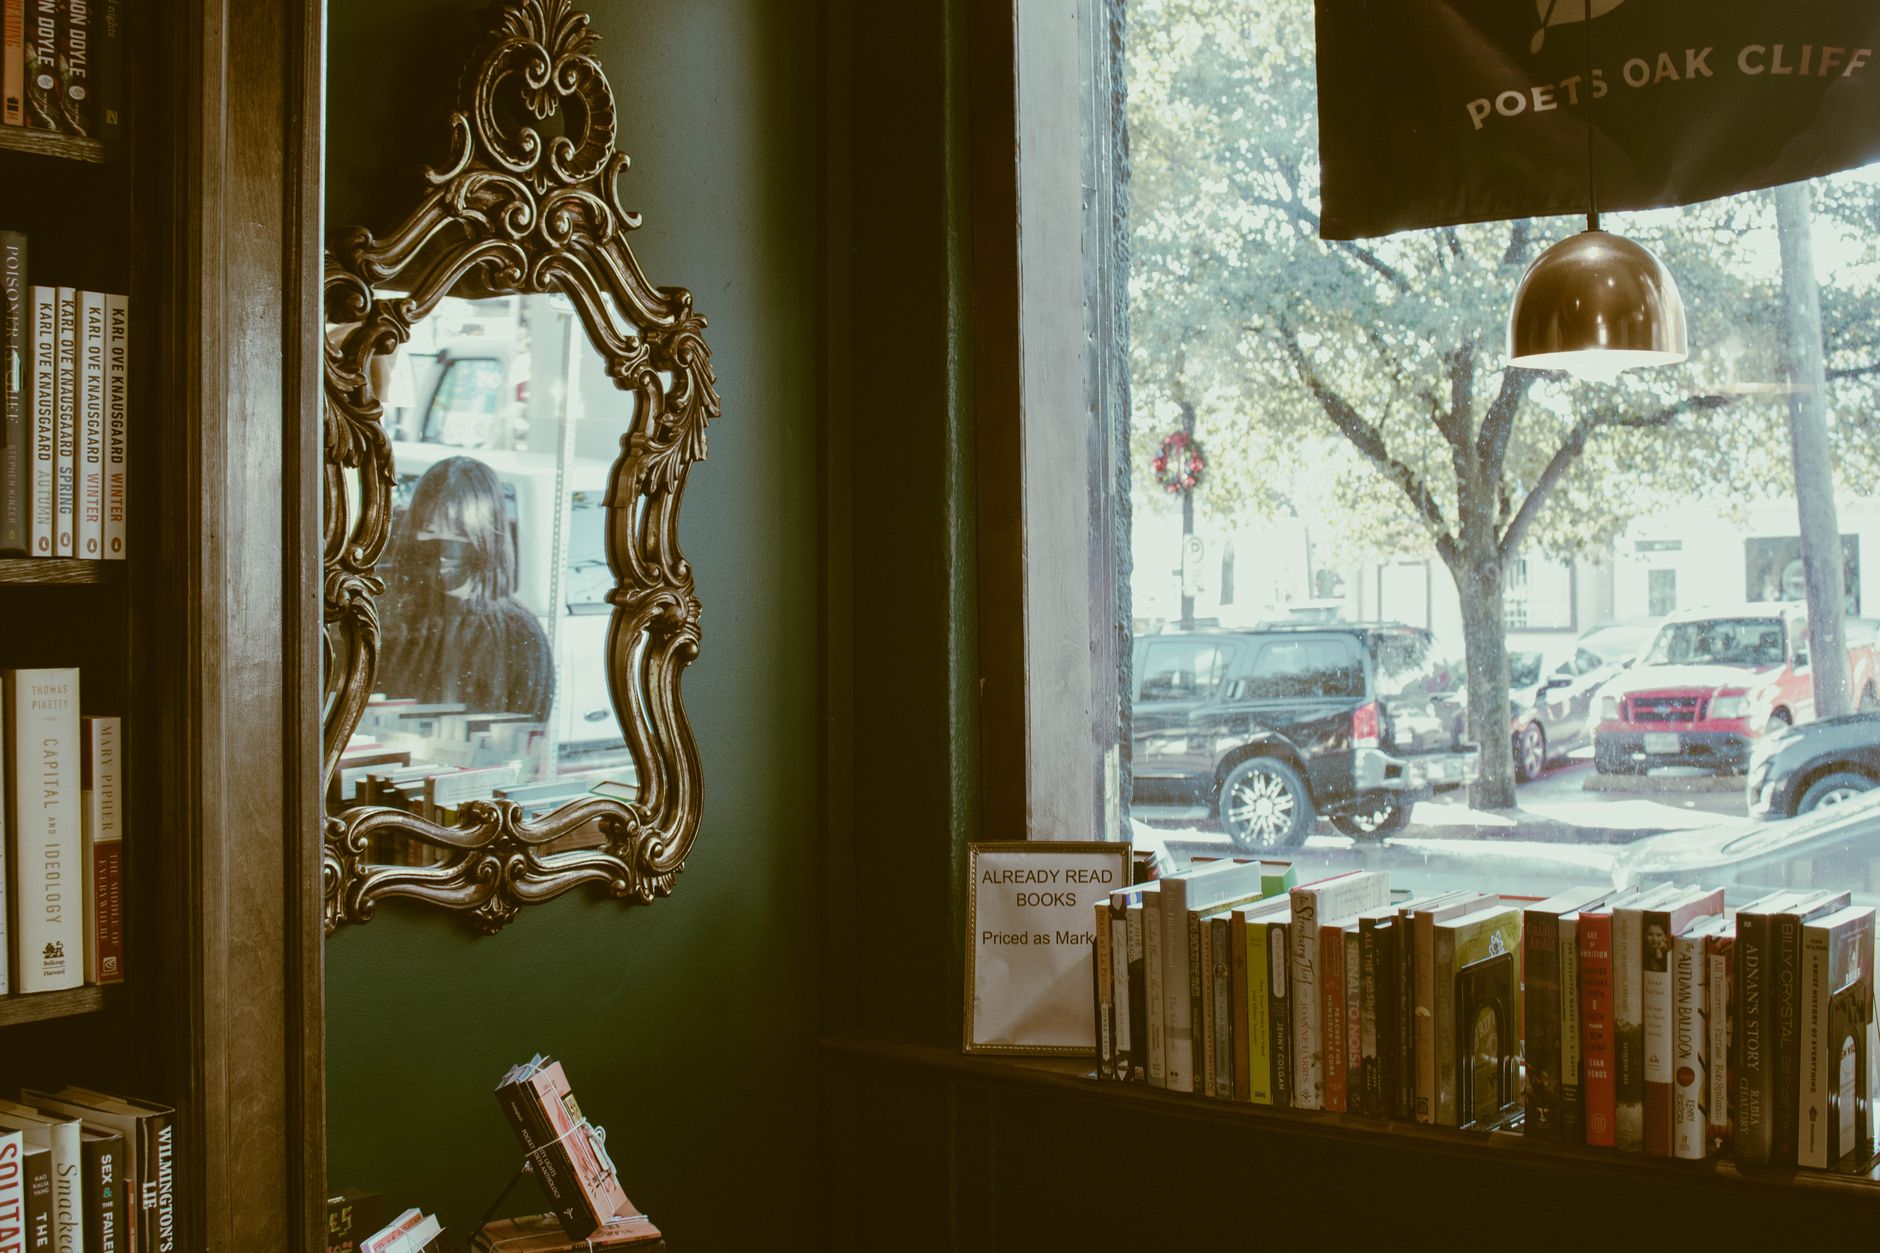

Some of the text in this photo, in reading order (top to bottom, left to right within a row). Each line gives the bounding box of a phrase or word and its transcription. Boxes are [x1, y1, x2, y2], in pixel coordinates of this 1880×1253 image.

[38, 17, 55, 67] DOYLE
[69, 29, 87, 78] DOYLE
[1466, 43, 1873, 131] POETS OAK CLIFF
[37, 303, 53, 525] KARL OVE KNAUSGAARD AUTUMN
[60, 300, 74, 514] KARL OVE KNAUSGAARD SPRING
[86, 307, 101, 523] KARL OVE KNAUSGAARD WINTER
[110, 308, 125, 523] KARL OVE KNAUSGAARD WINTER
[100, 725, 114, 832] MARY PIPHER
[43, 738, 62, 925] CAPITAL AND IDEOLOGY
[982, 869, 1113, 884] ALREADY READ
[1016, 892, 1077, 907] BOOKS
[982, 931, 1028, 945] Priced
[1033, 934, 1051, 945] as
[1365, 931, 1373, 951] ALL
[1586, 932, 1598, 940] AGE
[1780, 923, 1794, 968] BILLY
[1365, 953, 1374, 972] THE
[1678, 952, 1692, 1004] AUTUMN
[1349, 942, 1361, 1070] SIGNAL TO NOISE
[1746, 943, 1760, 1072] ADNAN'S STORY
[1780, 969, 1794, 1049] CRYSTAL
[1678, 1006, 1692, 1059] BALLOON
[1811, 1028, 1818, 1039] OF
[1277, 1052, 1286, 1090] COLGAN
[1715, 1064, 1724, 1081] Rob
[1749, 1089, 1760, 1126] RABIA
[101, 1153, 114, 1253] SEX & THE FAILE
[142, 1180, 157, 1210] LIE
[158, 1124, 174, 1253] WILMINGTON'S
[540, 1165, 561, 1200] ANTHOLOGY
[36, 1212, 48, 1248] THE
